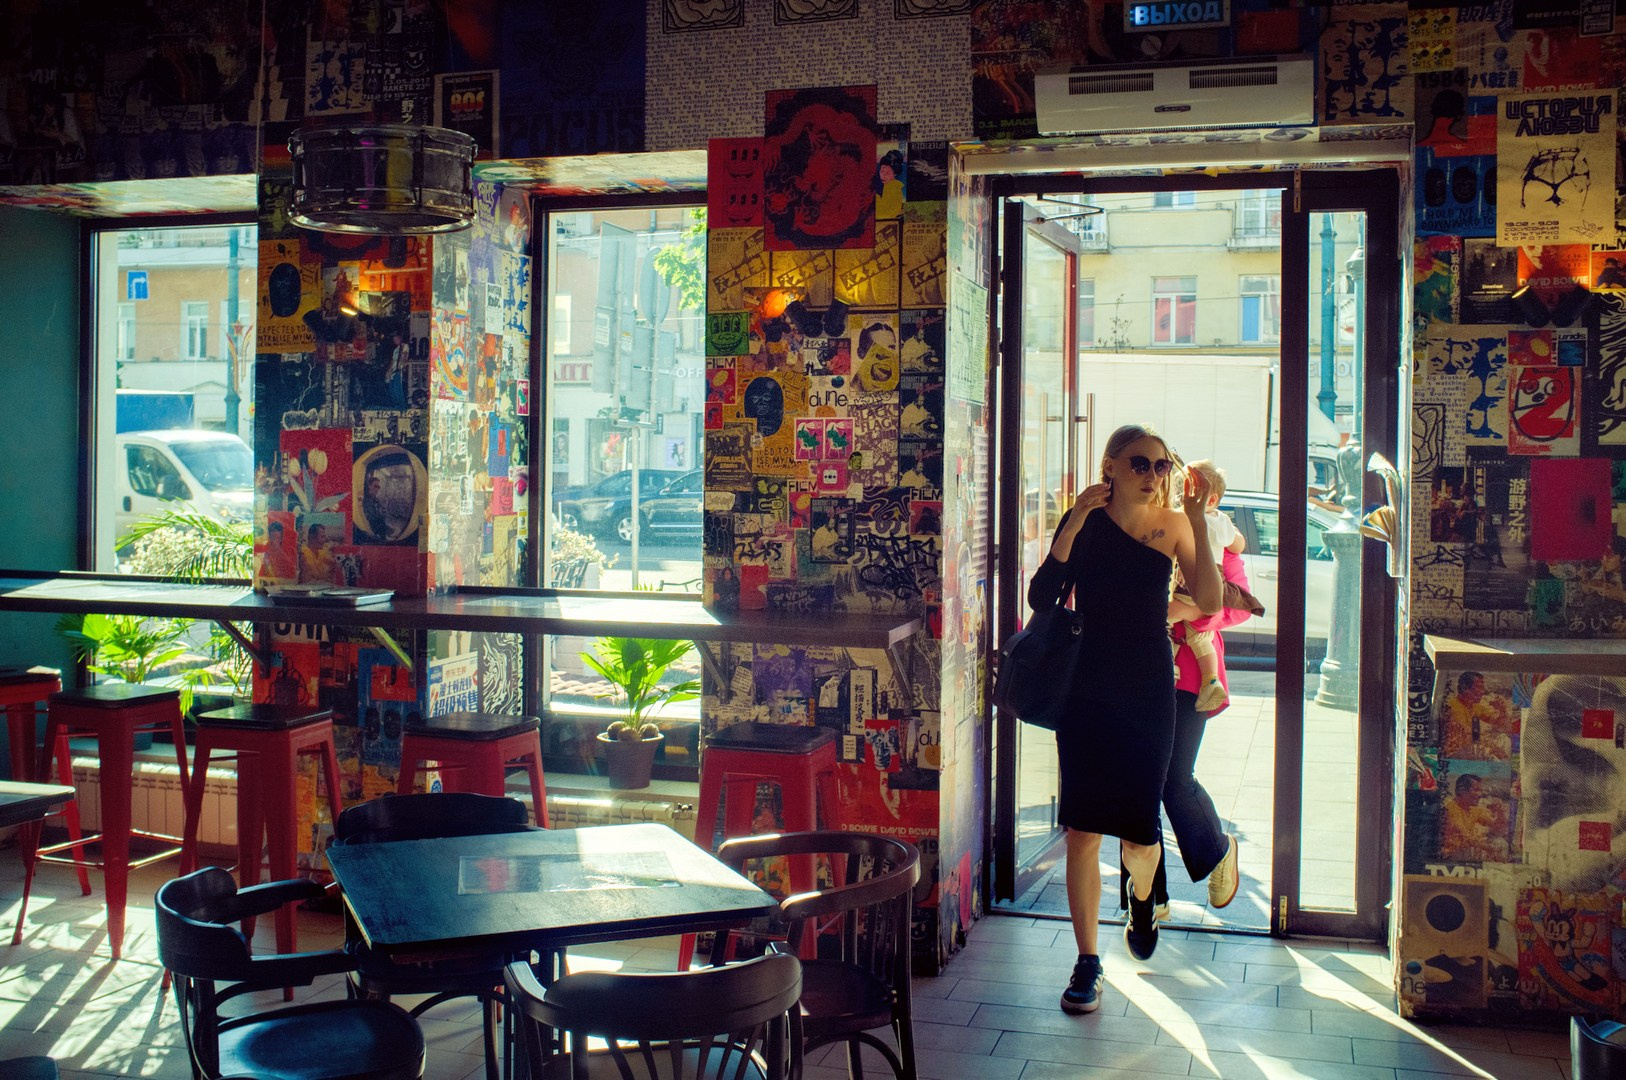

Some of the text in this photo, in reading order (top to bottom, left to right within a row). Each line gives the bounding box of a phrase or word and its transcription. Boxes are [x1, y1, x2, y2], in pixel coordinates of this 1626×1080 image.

[1134, 2, 1221, 26] ВЫХОД
[1506, 95, 1612, 120] ИСТОРИЯ
[1520, 276, 1589, 287] DAVID BOWIE
[706, 357, 736, 369] FILM
[809, 390, 848, 407] dune
[789, 480, 817, 492] FILM
[911, 488, 940, 500] FILM
[1508, 478, 1527, 543] 游野之外
[849, 824, 878, 833] BOWIE
[880, 825, 906, 834] DAVID
[908, 827, 938, 836] BOWIE
